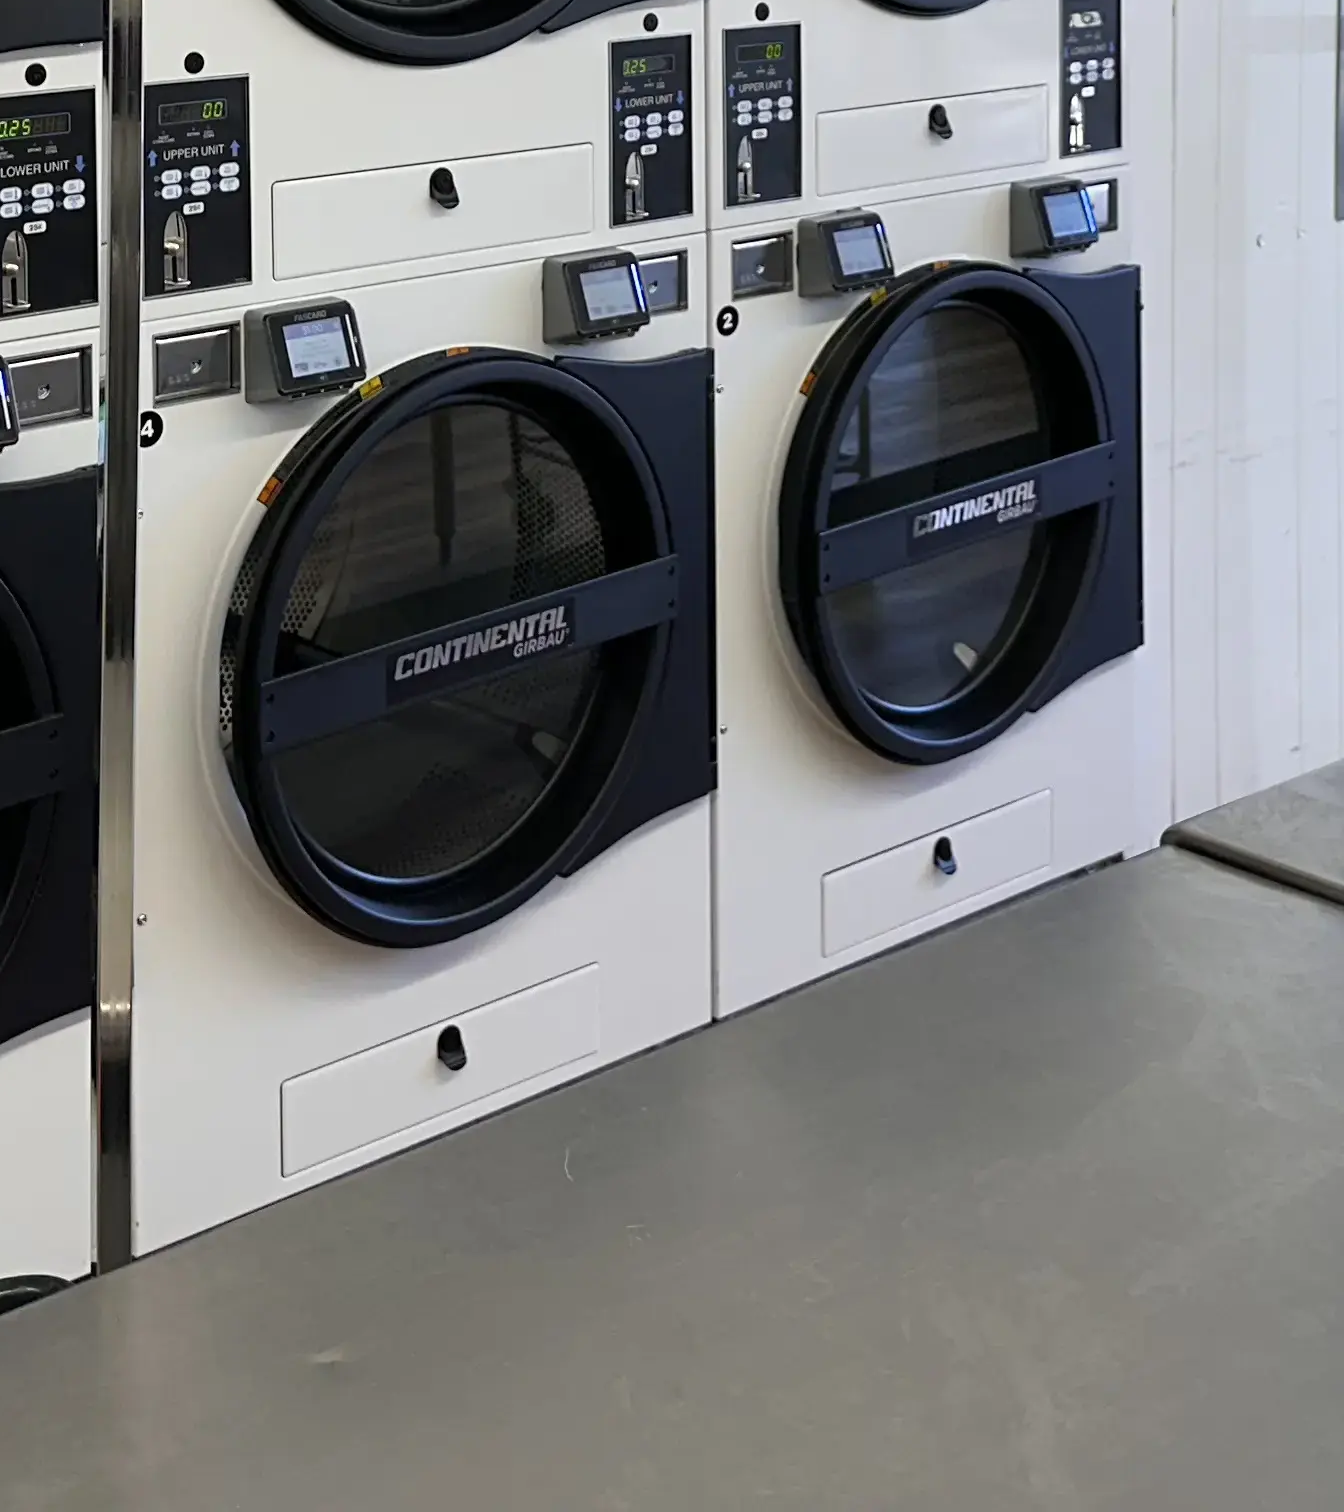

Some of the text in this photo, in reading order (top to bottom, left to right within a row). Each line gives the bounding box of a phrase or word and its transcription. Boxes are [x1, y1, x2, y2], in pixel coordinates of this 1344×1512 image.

[625, 93, 674, 108] LOWER UNIT
[202, 101, 223, 119] 00
[163, 143, 225, 161] UPPER UNIT
[0, 159, 70, 178] LOWER UNIT
[723, 313, 733, 329] 2
[141, 419, 154, 437] 4
[913, 480, 1037, 538] CONTINENTAL
[394, 605, 567, 681] CONTINENTAL
[513, 630, 566, 659] GIRBAU
